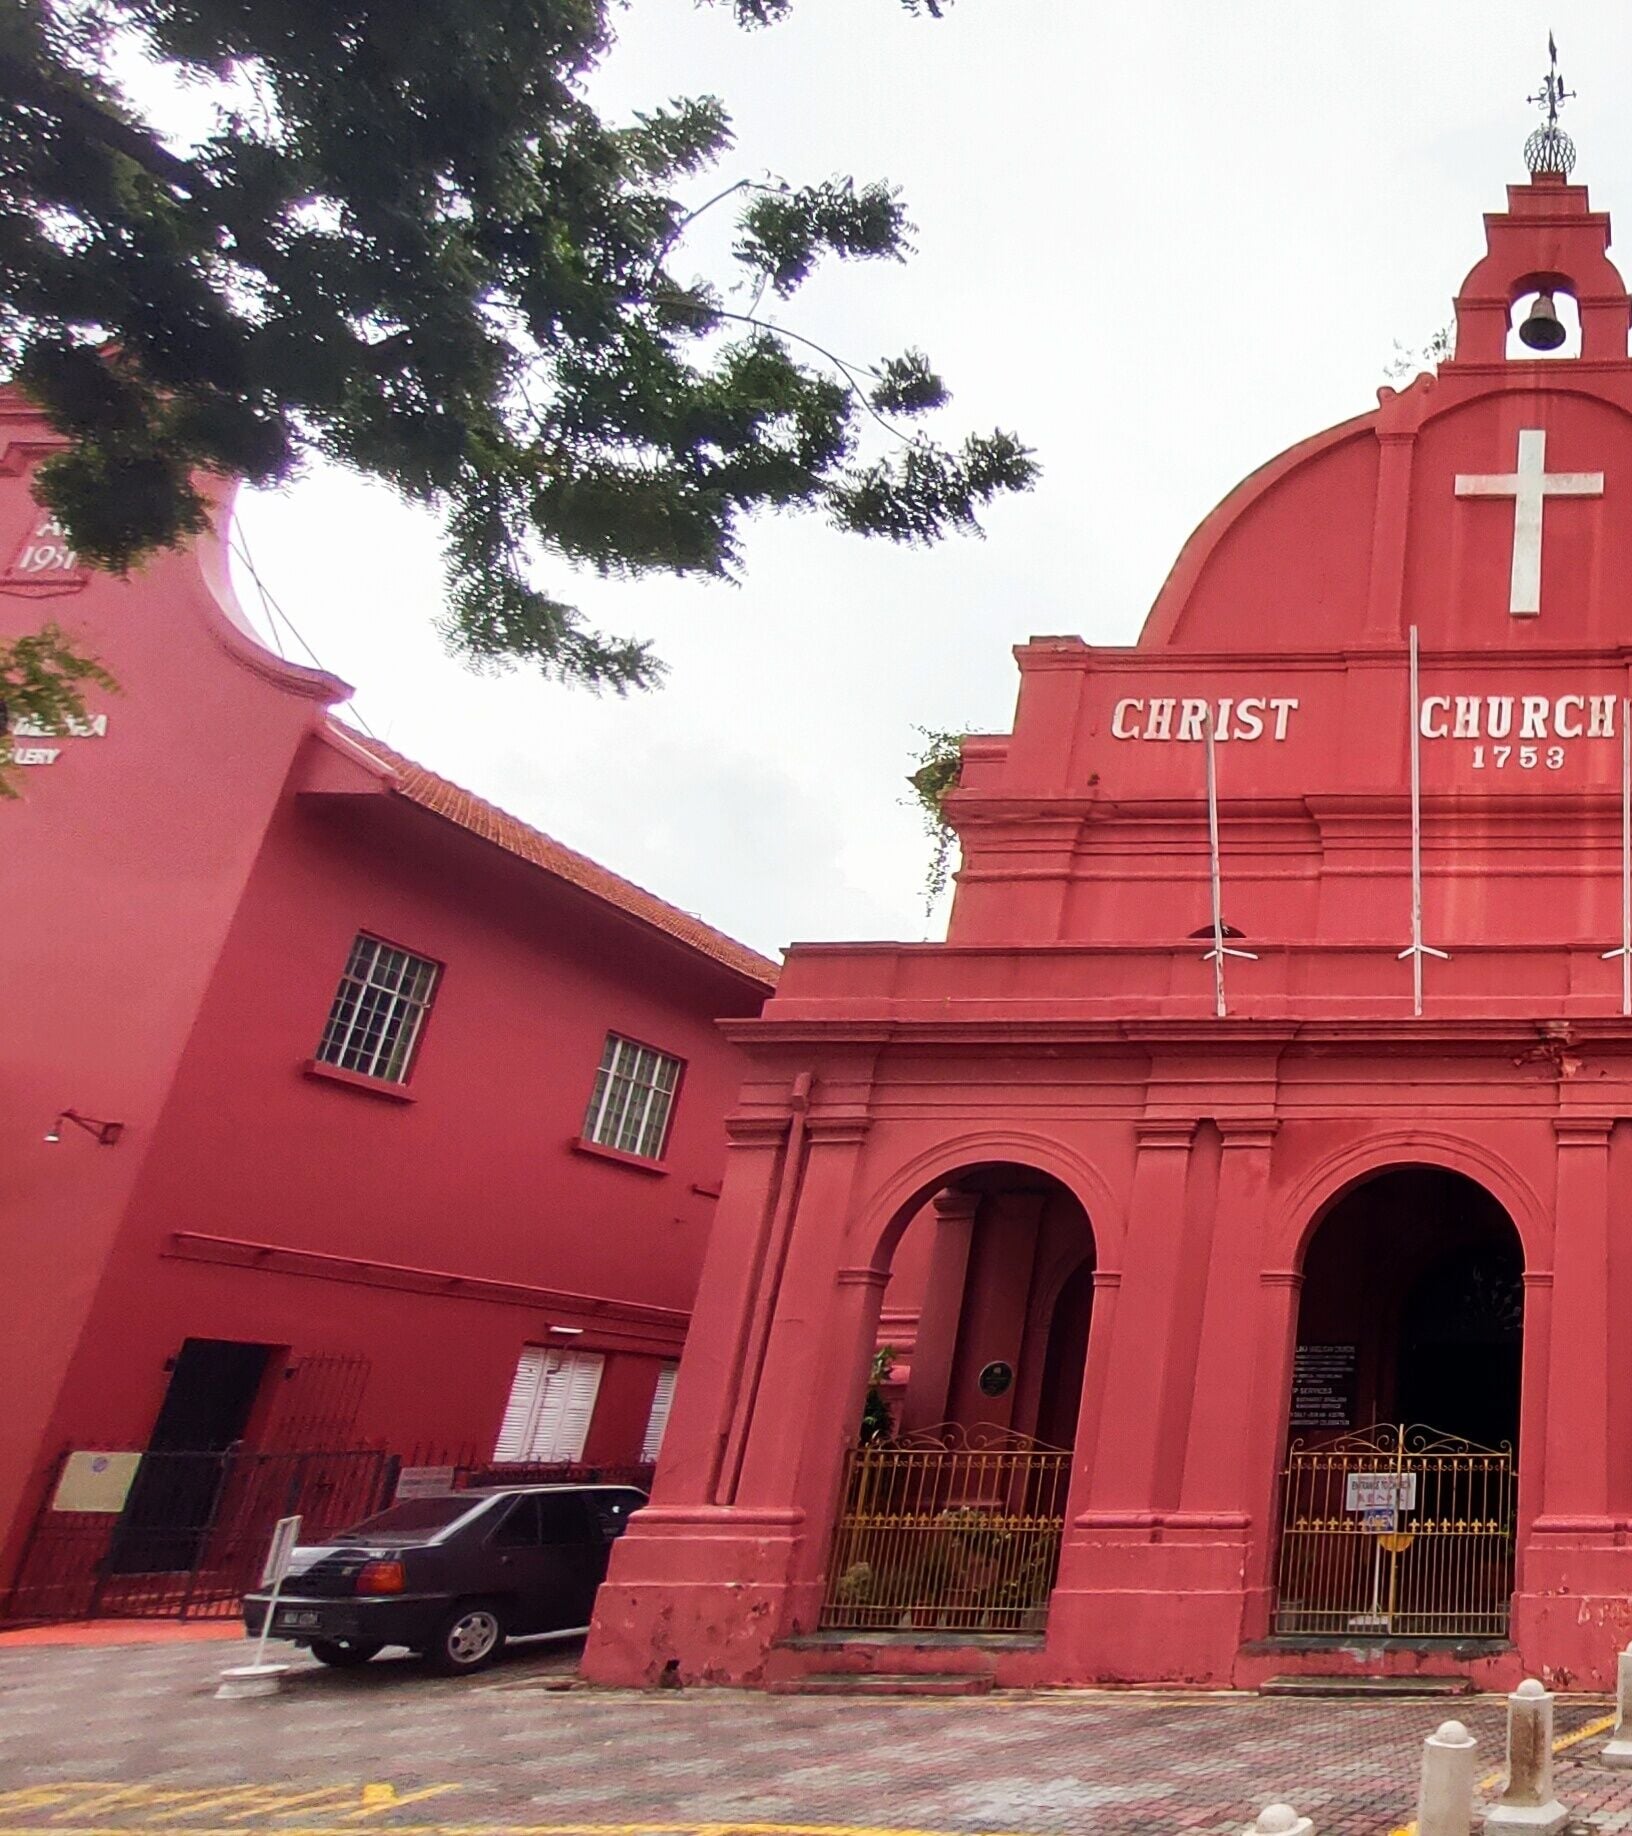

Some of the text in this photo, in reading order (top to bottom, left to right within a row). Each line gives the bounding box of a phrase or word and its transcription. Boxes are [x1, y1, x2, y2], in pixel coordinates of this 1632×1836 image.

[1111, 697, 1299, 741] CHRIST
[1419, 694, 1617, 739] CHURCH
[1471, 745, 1565, 769] 1753
